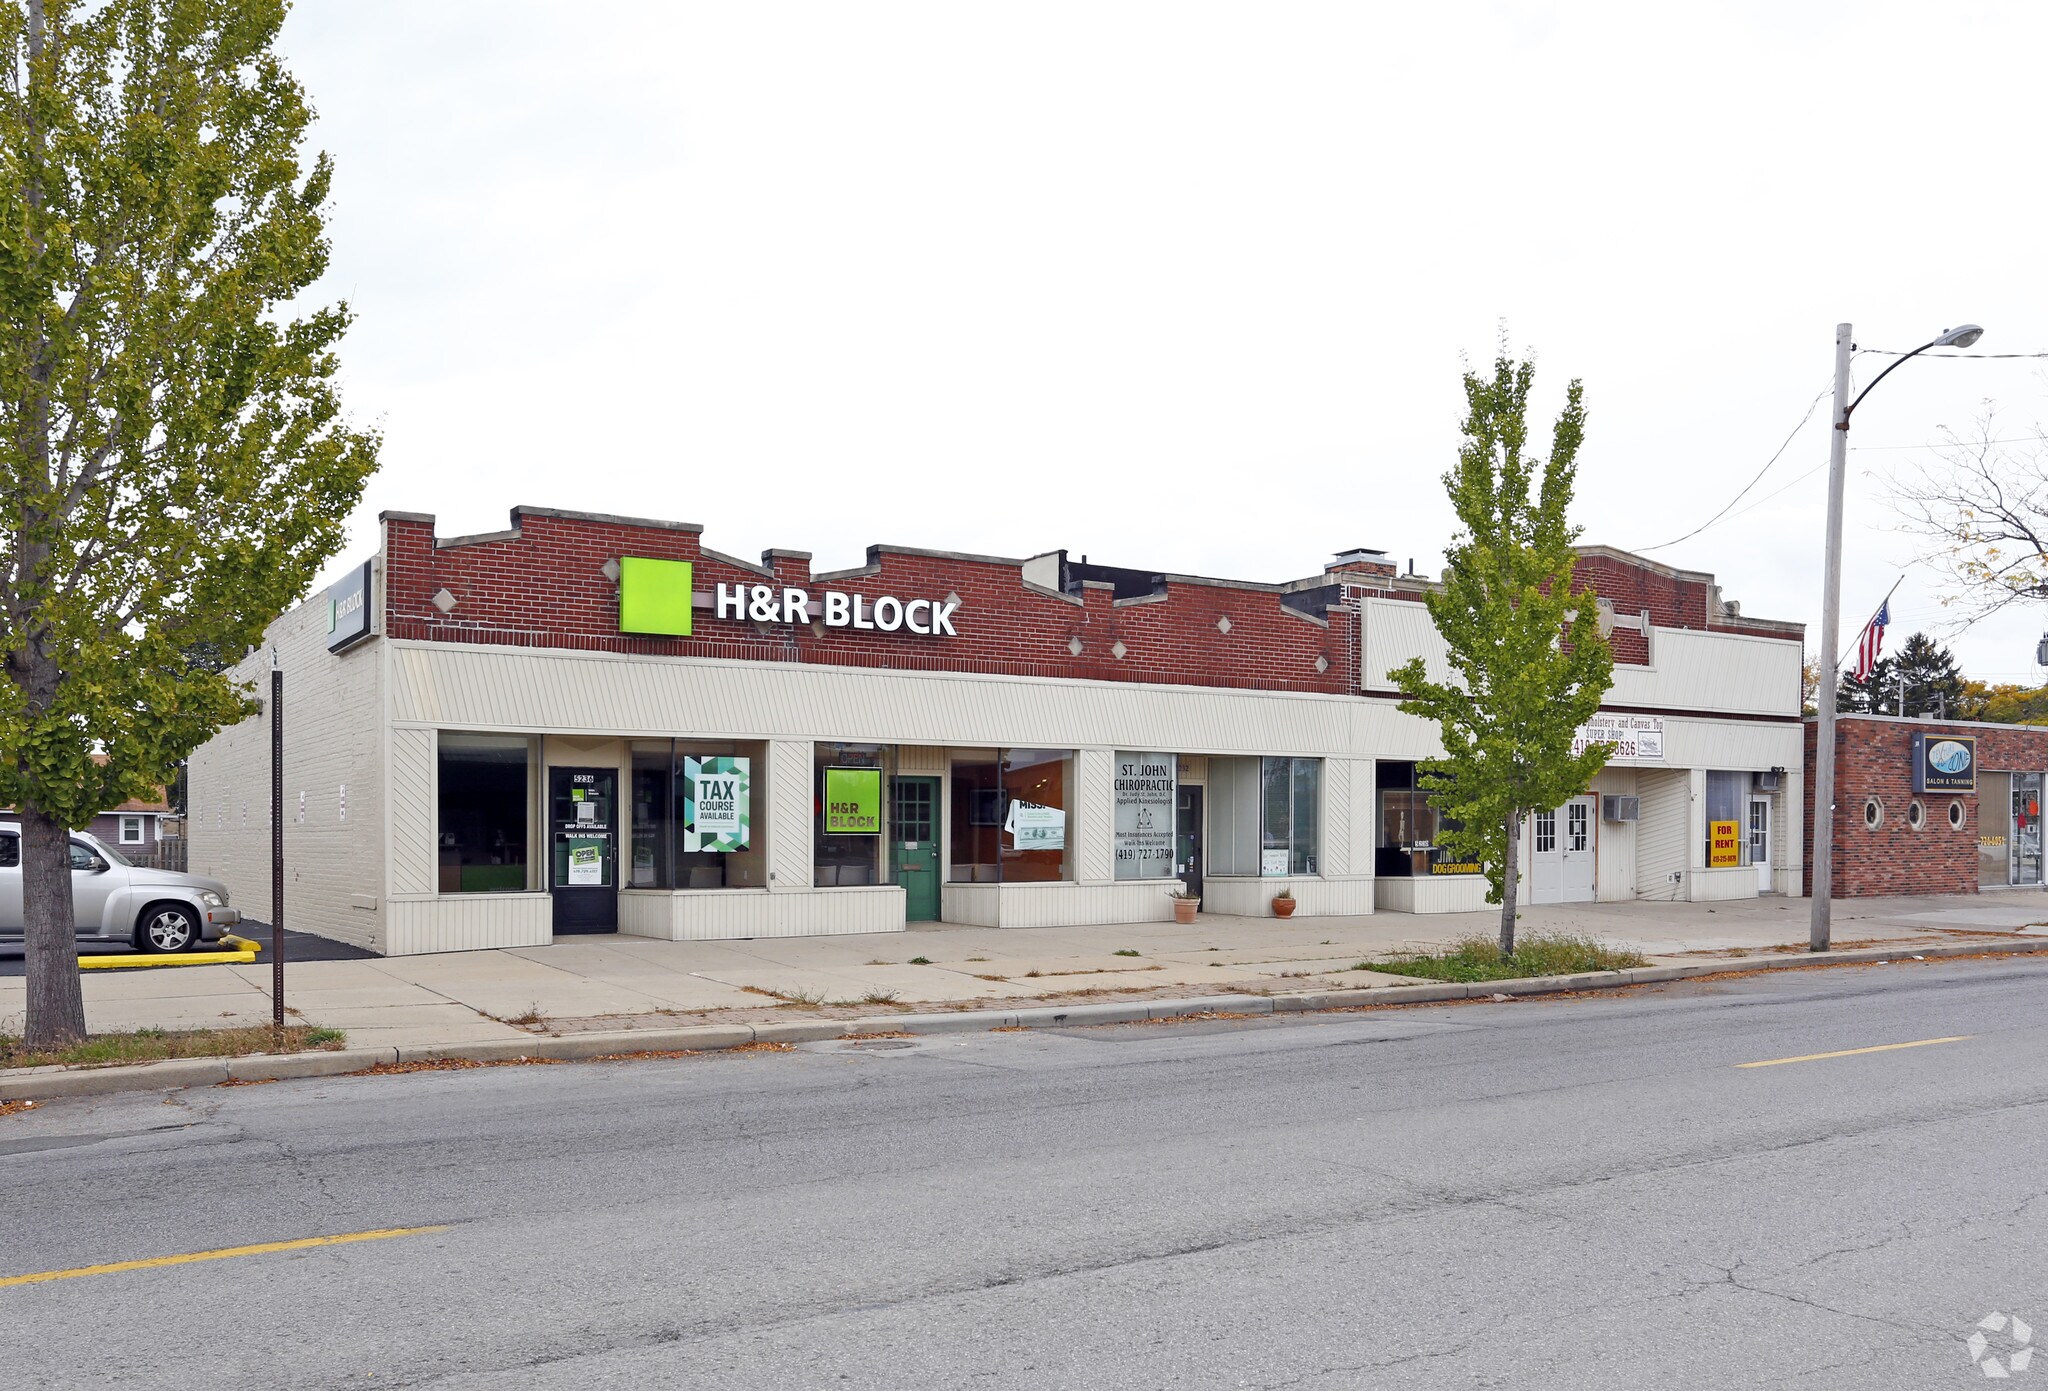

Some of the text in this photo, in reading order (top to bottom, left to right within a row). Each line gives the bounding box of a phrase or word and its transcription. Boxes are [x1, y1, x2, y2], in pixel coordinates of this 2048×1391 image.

[336, 588, 363, 621] H&R BLOCK
[716, 582, 957, 636] H&R BLOCK
[1587, 715, 1615, 729] pholstery
[1618, 717, 1629, 729] and
[1630, 718, 1651, 729] Canvas
[1586, 728, 1605, 739] SUPER
[841, 753, 865, 764] OPEN
[1122, 764, 1167, 777] ST. JOHN
[573, 775, 594, 783] 5236
[1114, 778, 1174, 791] CHIROPRACTIC
[1951, 778, 1973, 786] TANNING
[700, 780, 734, 800] TAX
[700, 800, 734, 811] COURSE
[1117, 797, 1173, 806] Applied Kinesiologist
[830, 802, 859, 814] H&R
[700, 812, 734, 820] AVAILABLE
[830, 816, 875, 828] BLOCK
[1153, 831, 1173, 839] Accepted
[1717, 825, 1732, 835] FOR
[1715, 839, 1735, 849] RENT
[575, 848, 596, 858] OPEN
[1115, 848, 1174, 861] (419) 727-1790
[1432, 863, 1482, 874] DOG GROOMING
